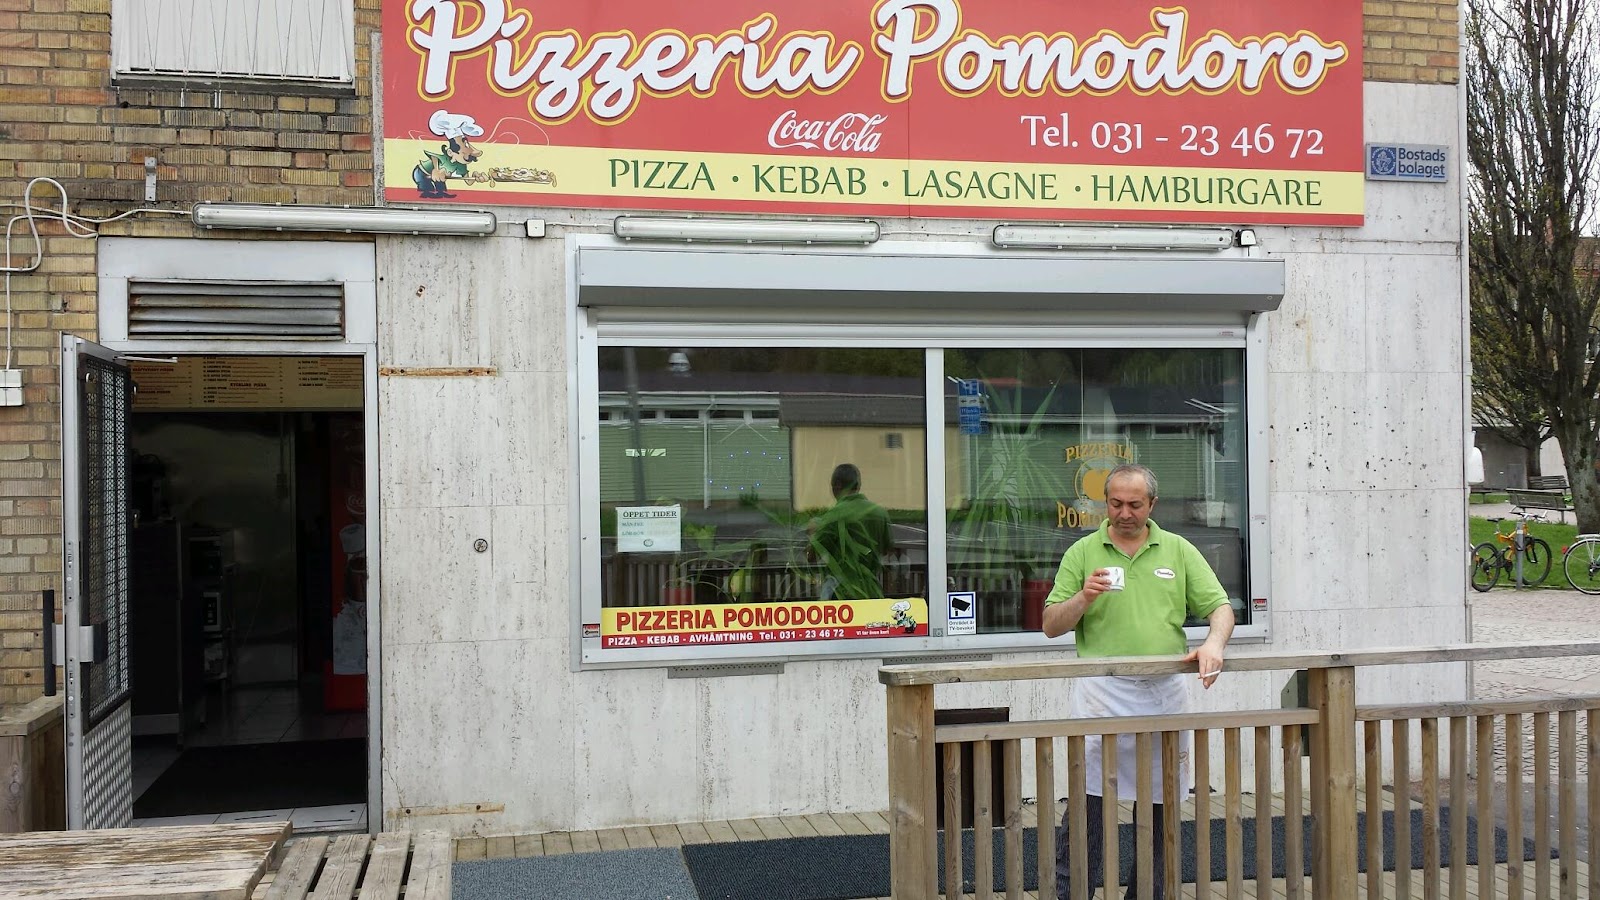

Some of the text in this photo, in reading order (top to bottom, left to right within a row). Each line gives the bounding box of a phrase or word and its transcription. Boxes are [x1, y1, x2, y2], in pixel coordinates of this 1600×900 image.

[876, 0, 1345, 100] Pomodoro
[767, 109, 888, 153] Coca-Cola
[1020, 112, 1078, 147] Tel.
[1091, 121, 1142, 154] 031
[1180, 124, 1219, 156] 23
[1231, 123, 1274, 157] 46
[1286, 128, 1324, 158] 72
[1398, 147, 1446, 162] Bostads
[608, 159, 1323, 206] PIZZA KEBAB LASAGNE HAMBURGARE
[1398, 161, 1446, 178] bolaget
[1065, 443, 1134, 464] PIZZERIA
[616, 604, 854, 632] PIZZERIA POMODORO
[608, 636, 637, 646] PIZZA
[647, 635, 680, 645] KEBAB
[759, 632, 776, 640] Tel.
[779, 630, 796, 639] 031
[805, 630, 816, 638] 23
[819, 629, 830, 638] 46
[833, 629, 845, 637] 72
